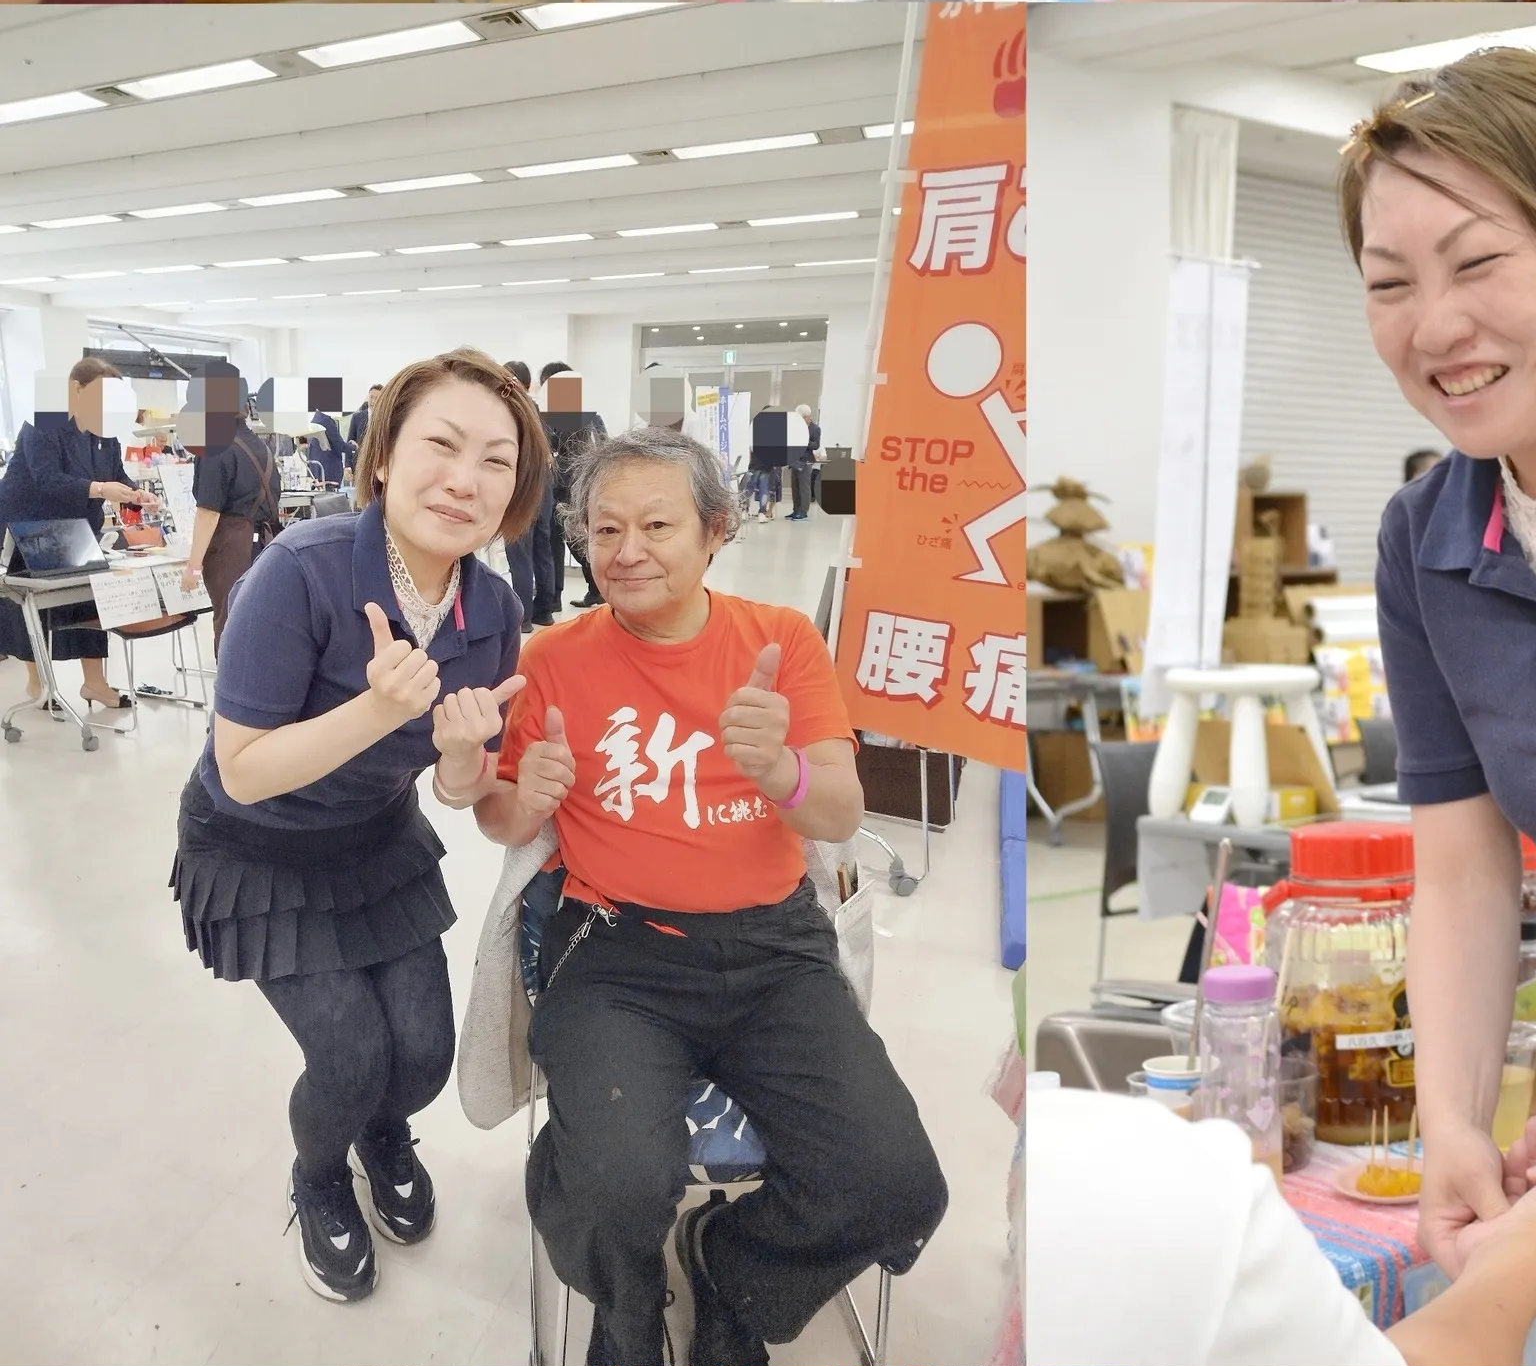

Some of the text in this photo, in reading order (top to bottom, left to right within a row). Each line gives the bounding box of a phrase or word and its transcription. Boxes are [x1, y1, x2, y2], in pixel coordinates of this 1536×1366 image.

[908, 162, 1026, 275] 肩
[879, 436, 975, 465] STOP
[896, 466, 948, 494] the
[917, 534, 952, 550] ひざ痛
[594, 706, 715, 830] 新
